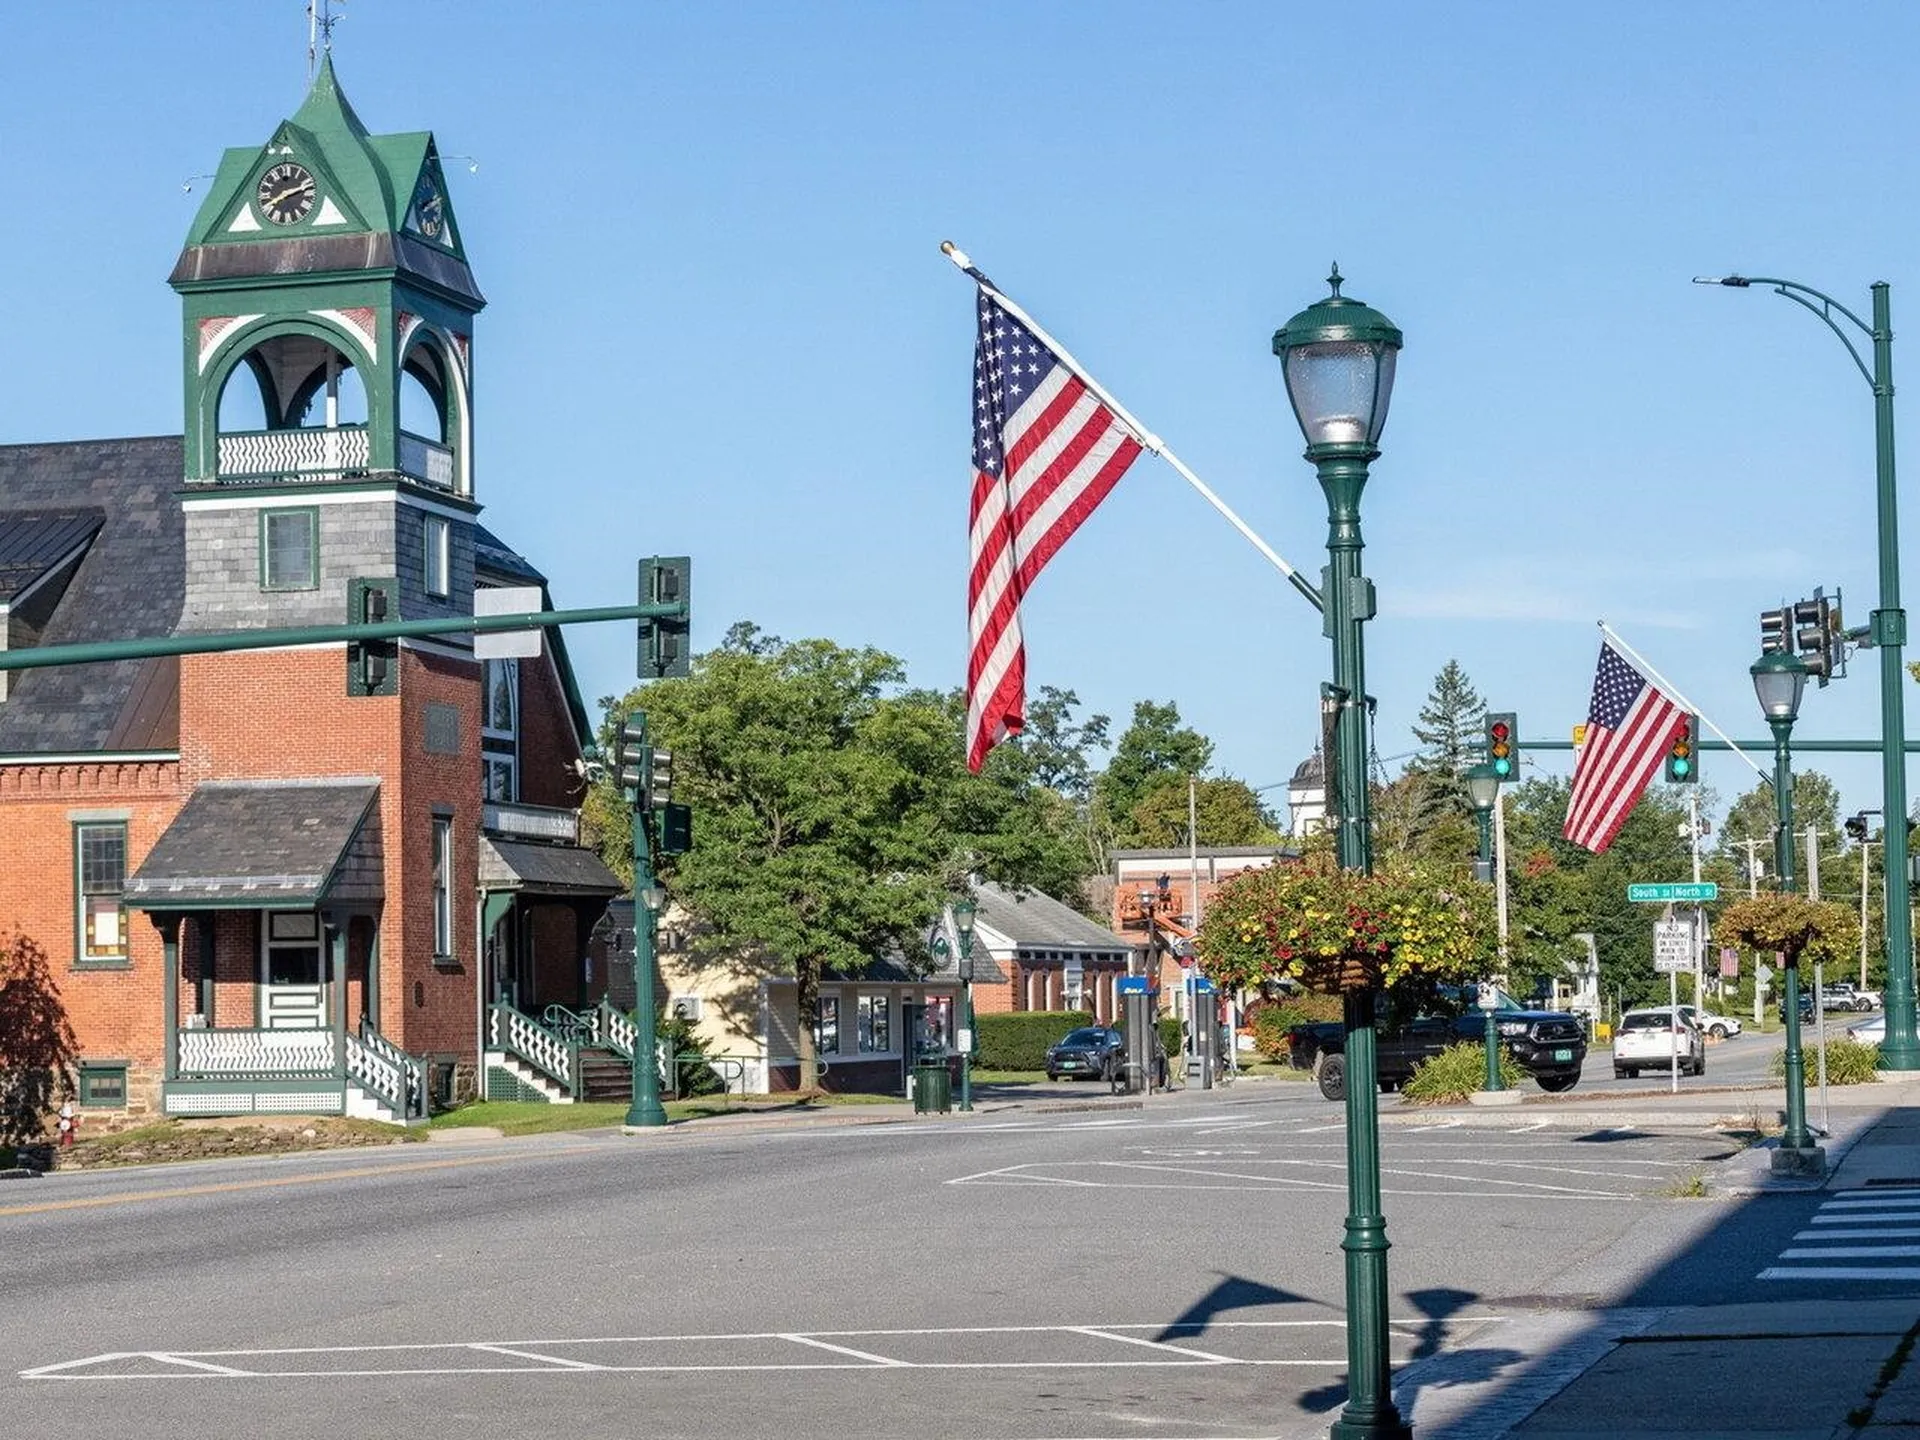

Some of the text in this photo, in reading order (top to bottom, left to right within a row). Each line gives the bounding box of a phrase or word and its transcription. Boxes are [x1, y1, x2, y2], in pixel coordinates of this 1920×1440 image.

[1632, 887, 1658, 898] South
[1675, 886, 1700, 897] North
[1666, 923, 1680, 932] NO
[1657, 931, 1689, 939] PARKING
